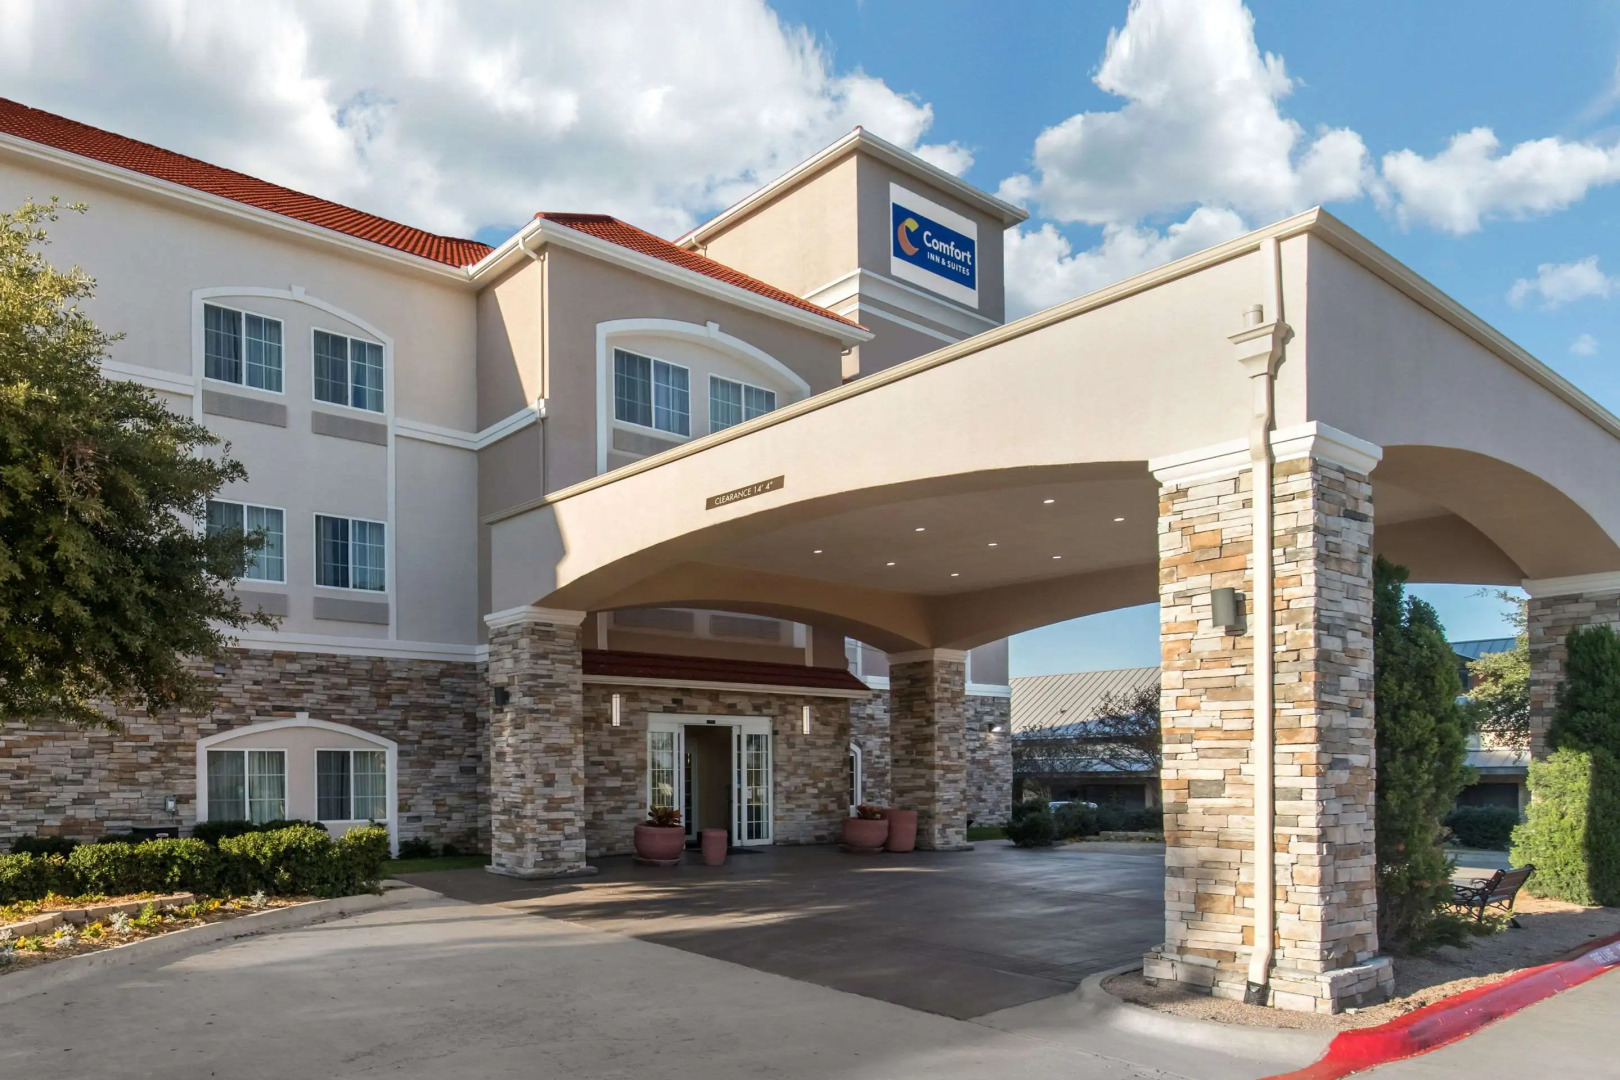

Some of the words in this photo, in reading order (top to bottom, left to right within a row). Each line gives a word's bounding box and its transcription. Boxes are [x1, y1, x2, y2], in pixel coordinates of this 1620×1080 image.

[923, 230, 972, 265] Comfort
[927, 251, 940, 264] INN
[941, 257, 946, 266] &
[947, 260, 970, 276] SUITES
[714, 487, 752, 505] CLEARANCE
